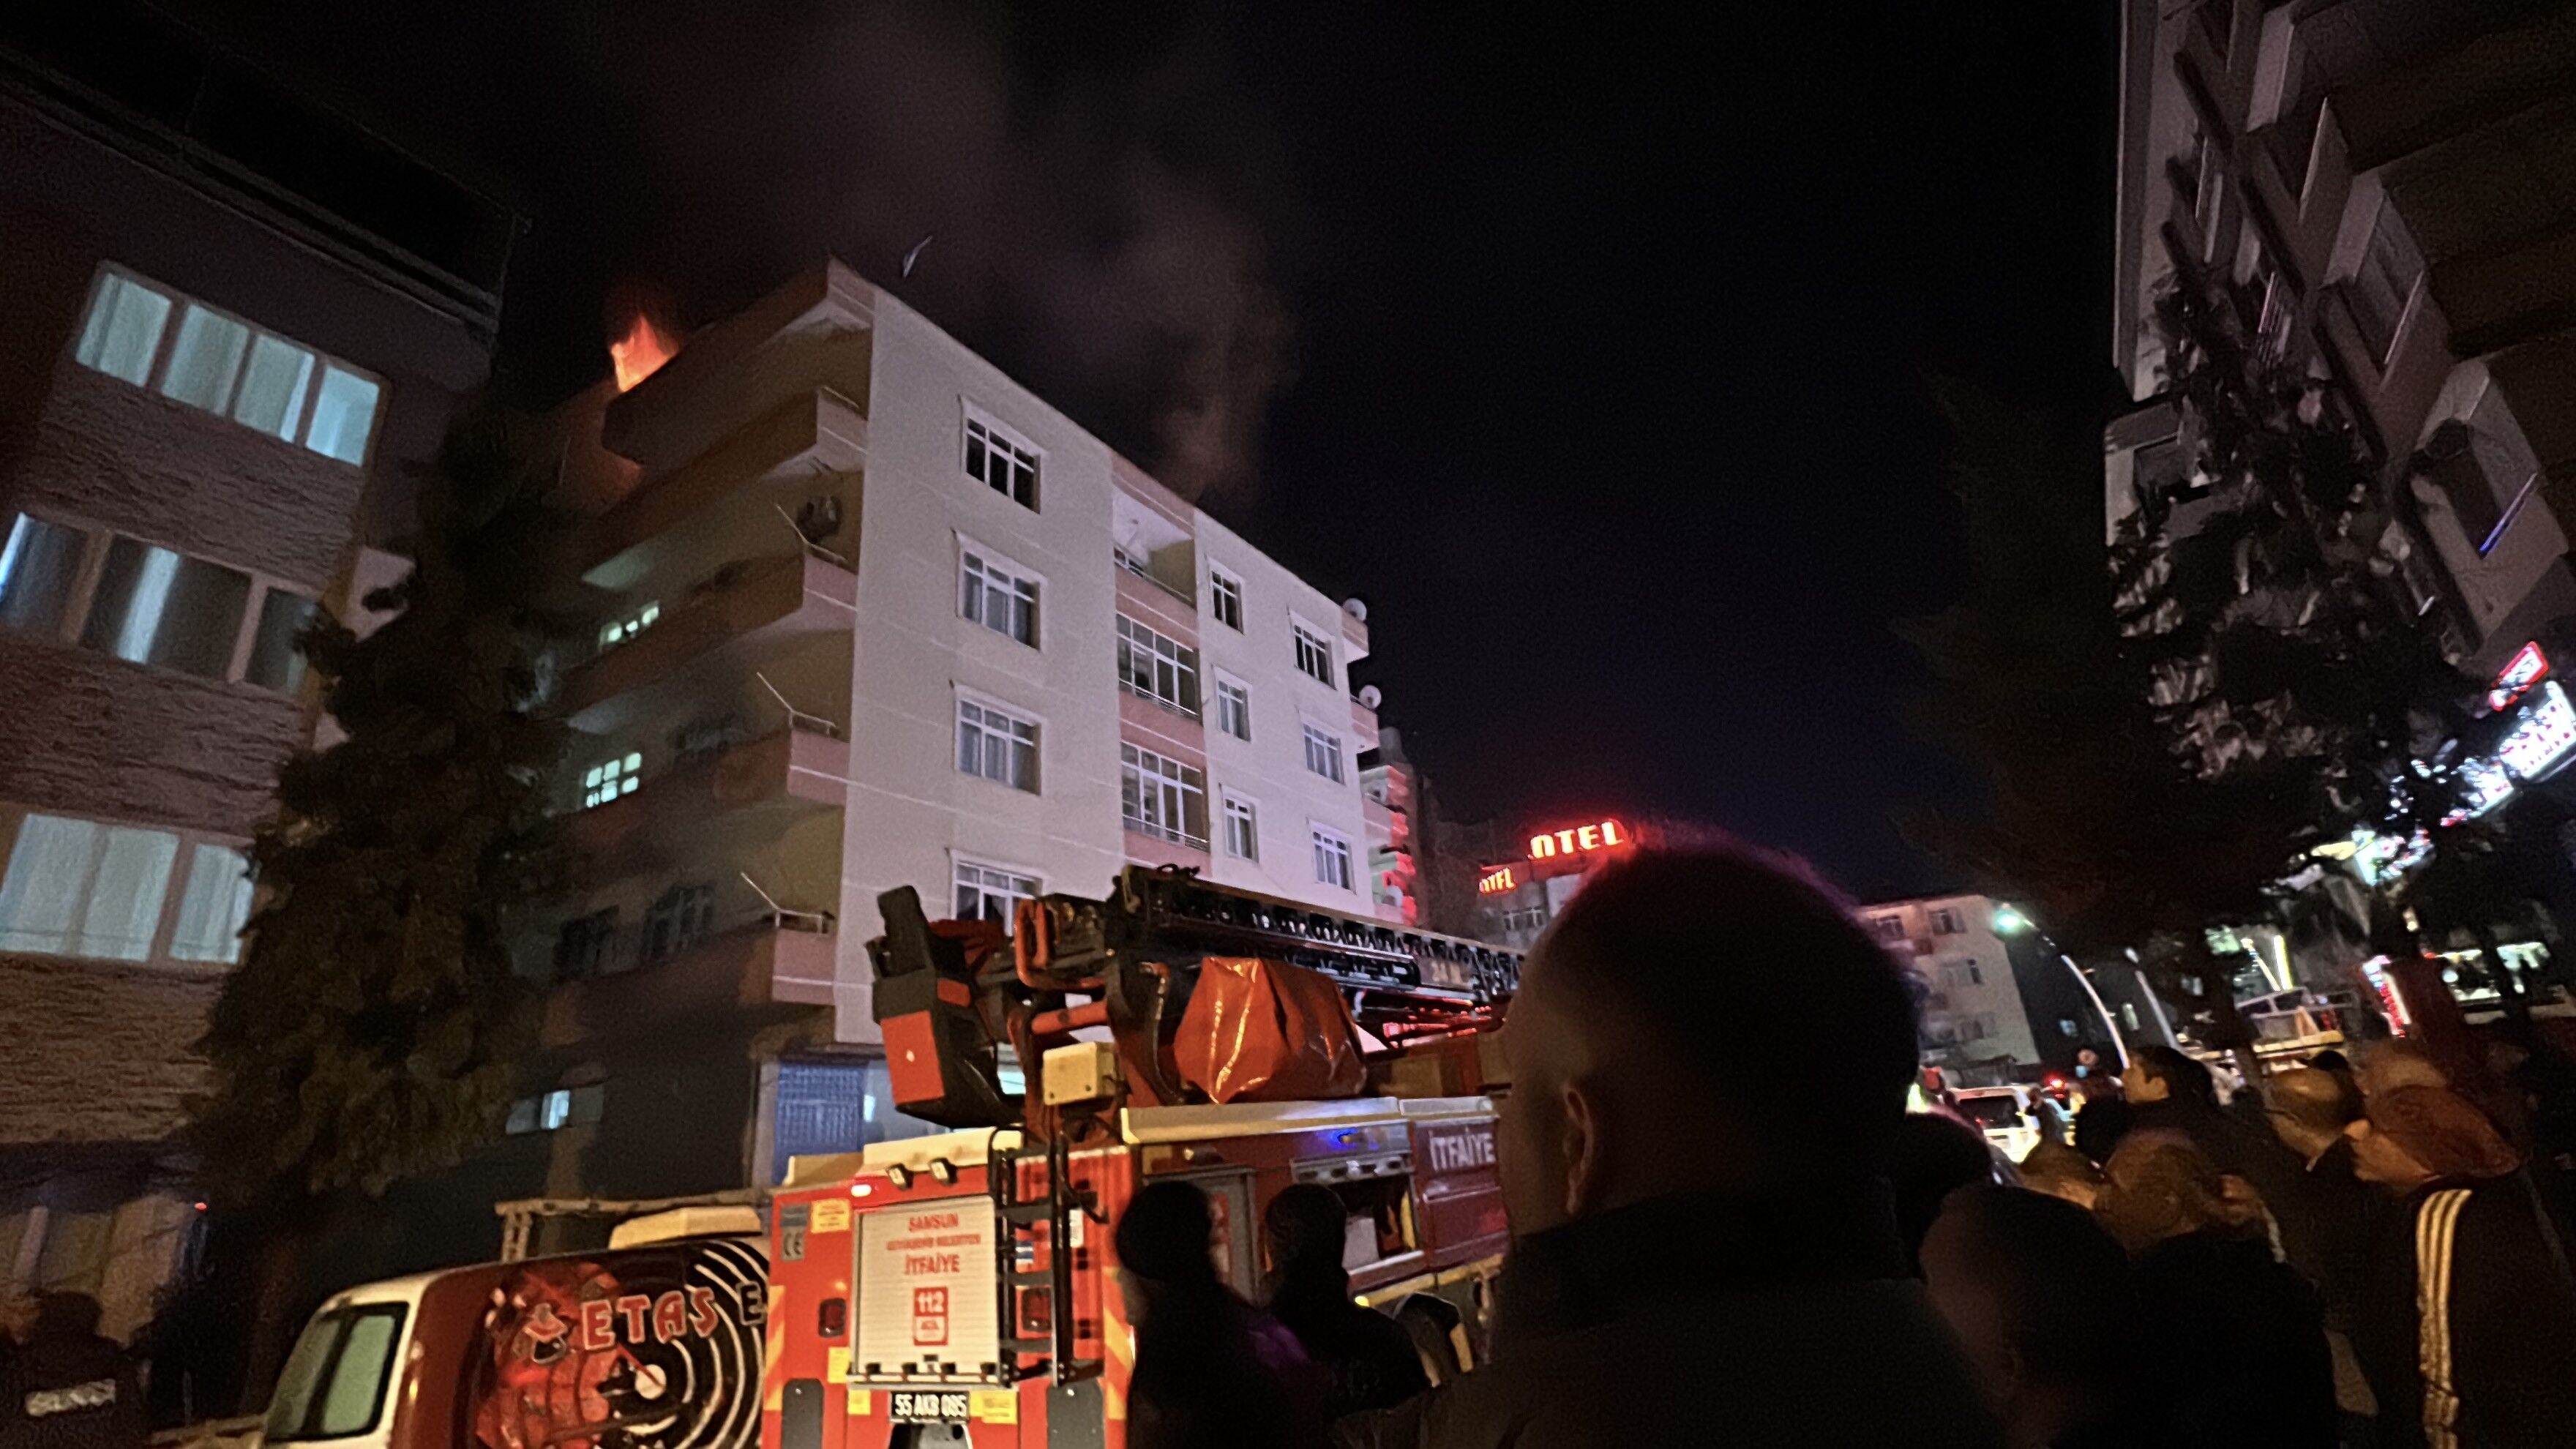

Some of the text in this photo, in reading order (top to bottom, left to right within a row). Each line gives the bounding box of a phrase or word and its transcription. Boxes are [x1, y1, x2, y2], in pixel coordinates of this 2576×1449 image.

[1530, 821, 1624, 859] OTEL
[1428, 1127, 1497, 1171] İTFAİYE
[908, 1213, 959, 1232] SAMSUN
[783, 1232, 803, 1257] CE
[905, 1252, 960, 1275] İTFAİYE
[918, 1292, 944, 1313] 112
[895, 1393, 913, 1415] 55
